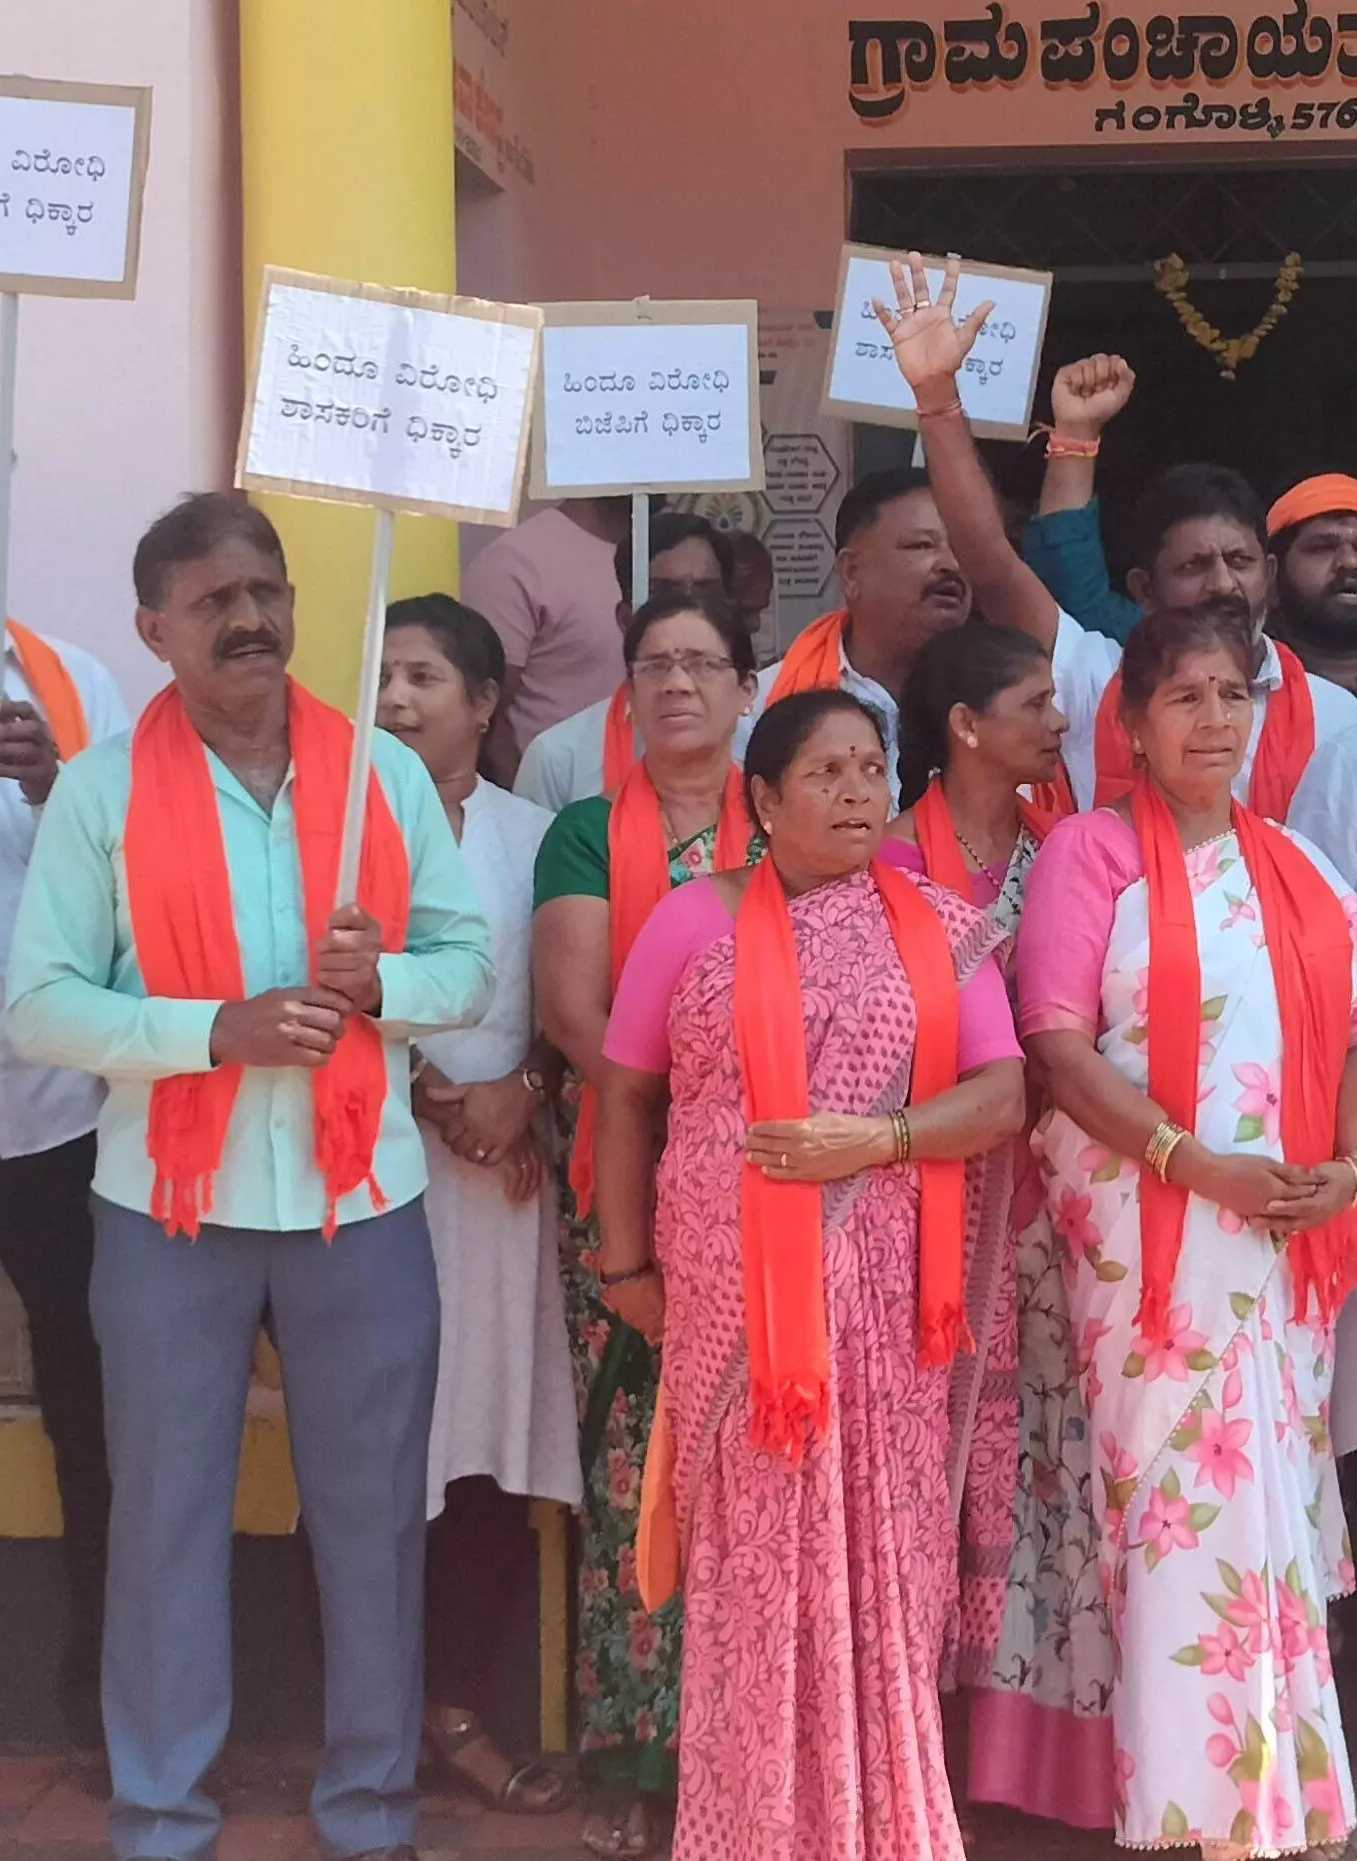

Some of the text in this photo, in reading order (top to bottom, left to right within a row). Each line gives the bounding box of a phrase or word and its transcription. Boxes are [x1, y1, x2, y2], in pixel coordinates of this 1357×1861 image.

[11, 148, 106, 182] ವಿರೋಧಿ
[25, 197, 95, 236] ಧಿಕ್ಕಾರ
[287, 343, 499, 404] ಹಿಂದೂ ವಿರೋಧಿ
[563, 368, 730, 394] ಹಿಂದೂ ವಿರೋಧಿ
[279, 396, 482, 459] ಶಾಸಕರಿಗೆ ಧಿಕ್ಕಾರ
[575, 410, 722, 444] ಬಿಜೆಪಿಗೆ ಧಿಕ್ಕಾರ
